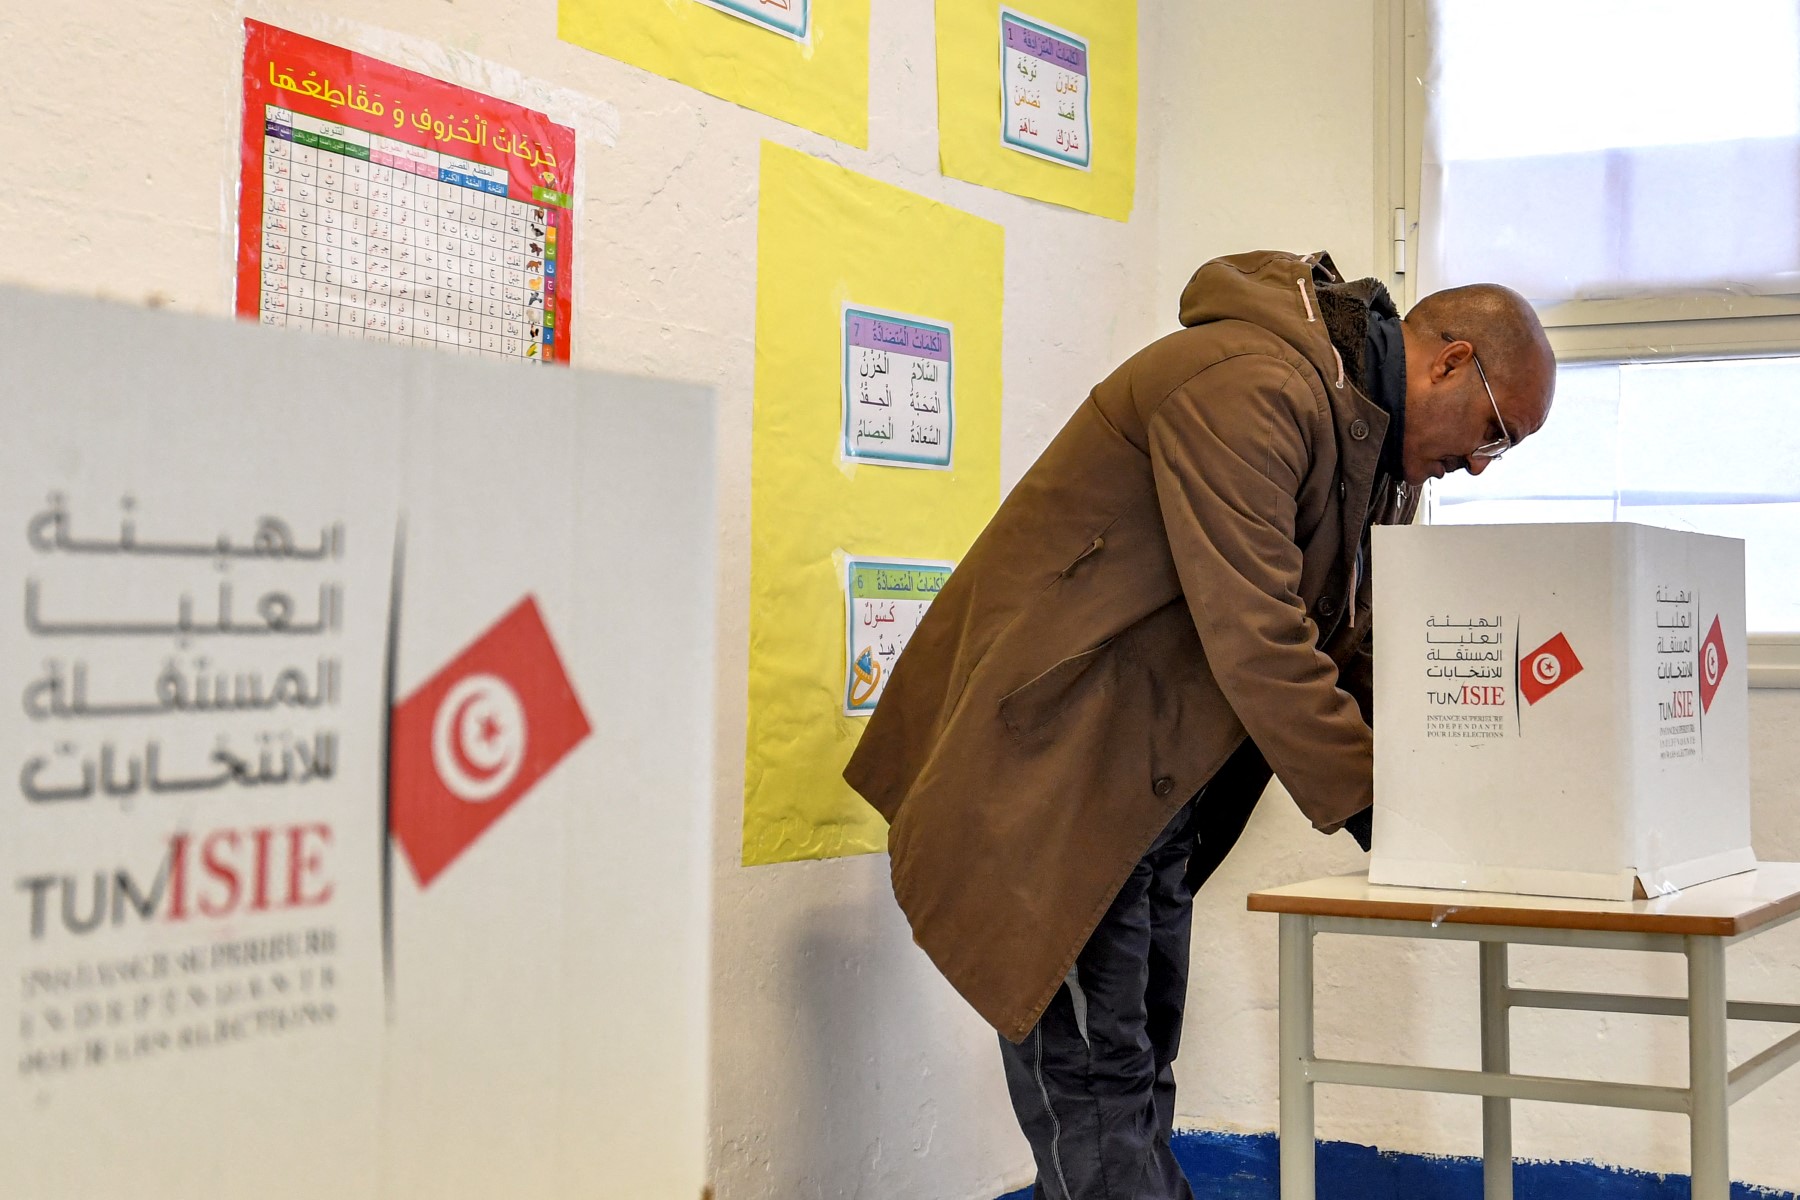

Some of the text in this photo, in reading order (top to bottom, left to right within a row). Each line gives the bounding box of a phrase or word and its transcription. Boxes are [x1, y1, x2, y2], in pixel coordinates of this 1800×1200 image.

[1008, 28, 1013, 40] 1
[854, 323, 860, 338] 7
[858, 575, 863, 589] 6
[24, 577, 345, 649] العليا
[1426, 614, 1502, 630] الهيئة
[1426, 632, 1502, 646] العليا
[1426, 648, 1502, 662] المستقلة
[1426, 666, 1502, 680] للانتخابات
[21, 657, 341, 721] المستقلة
[1427, 682, 1505, 706] TUNISIE
[19, 732, 338, 811] للانتخابات
